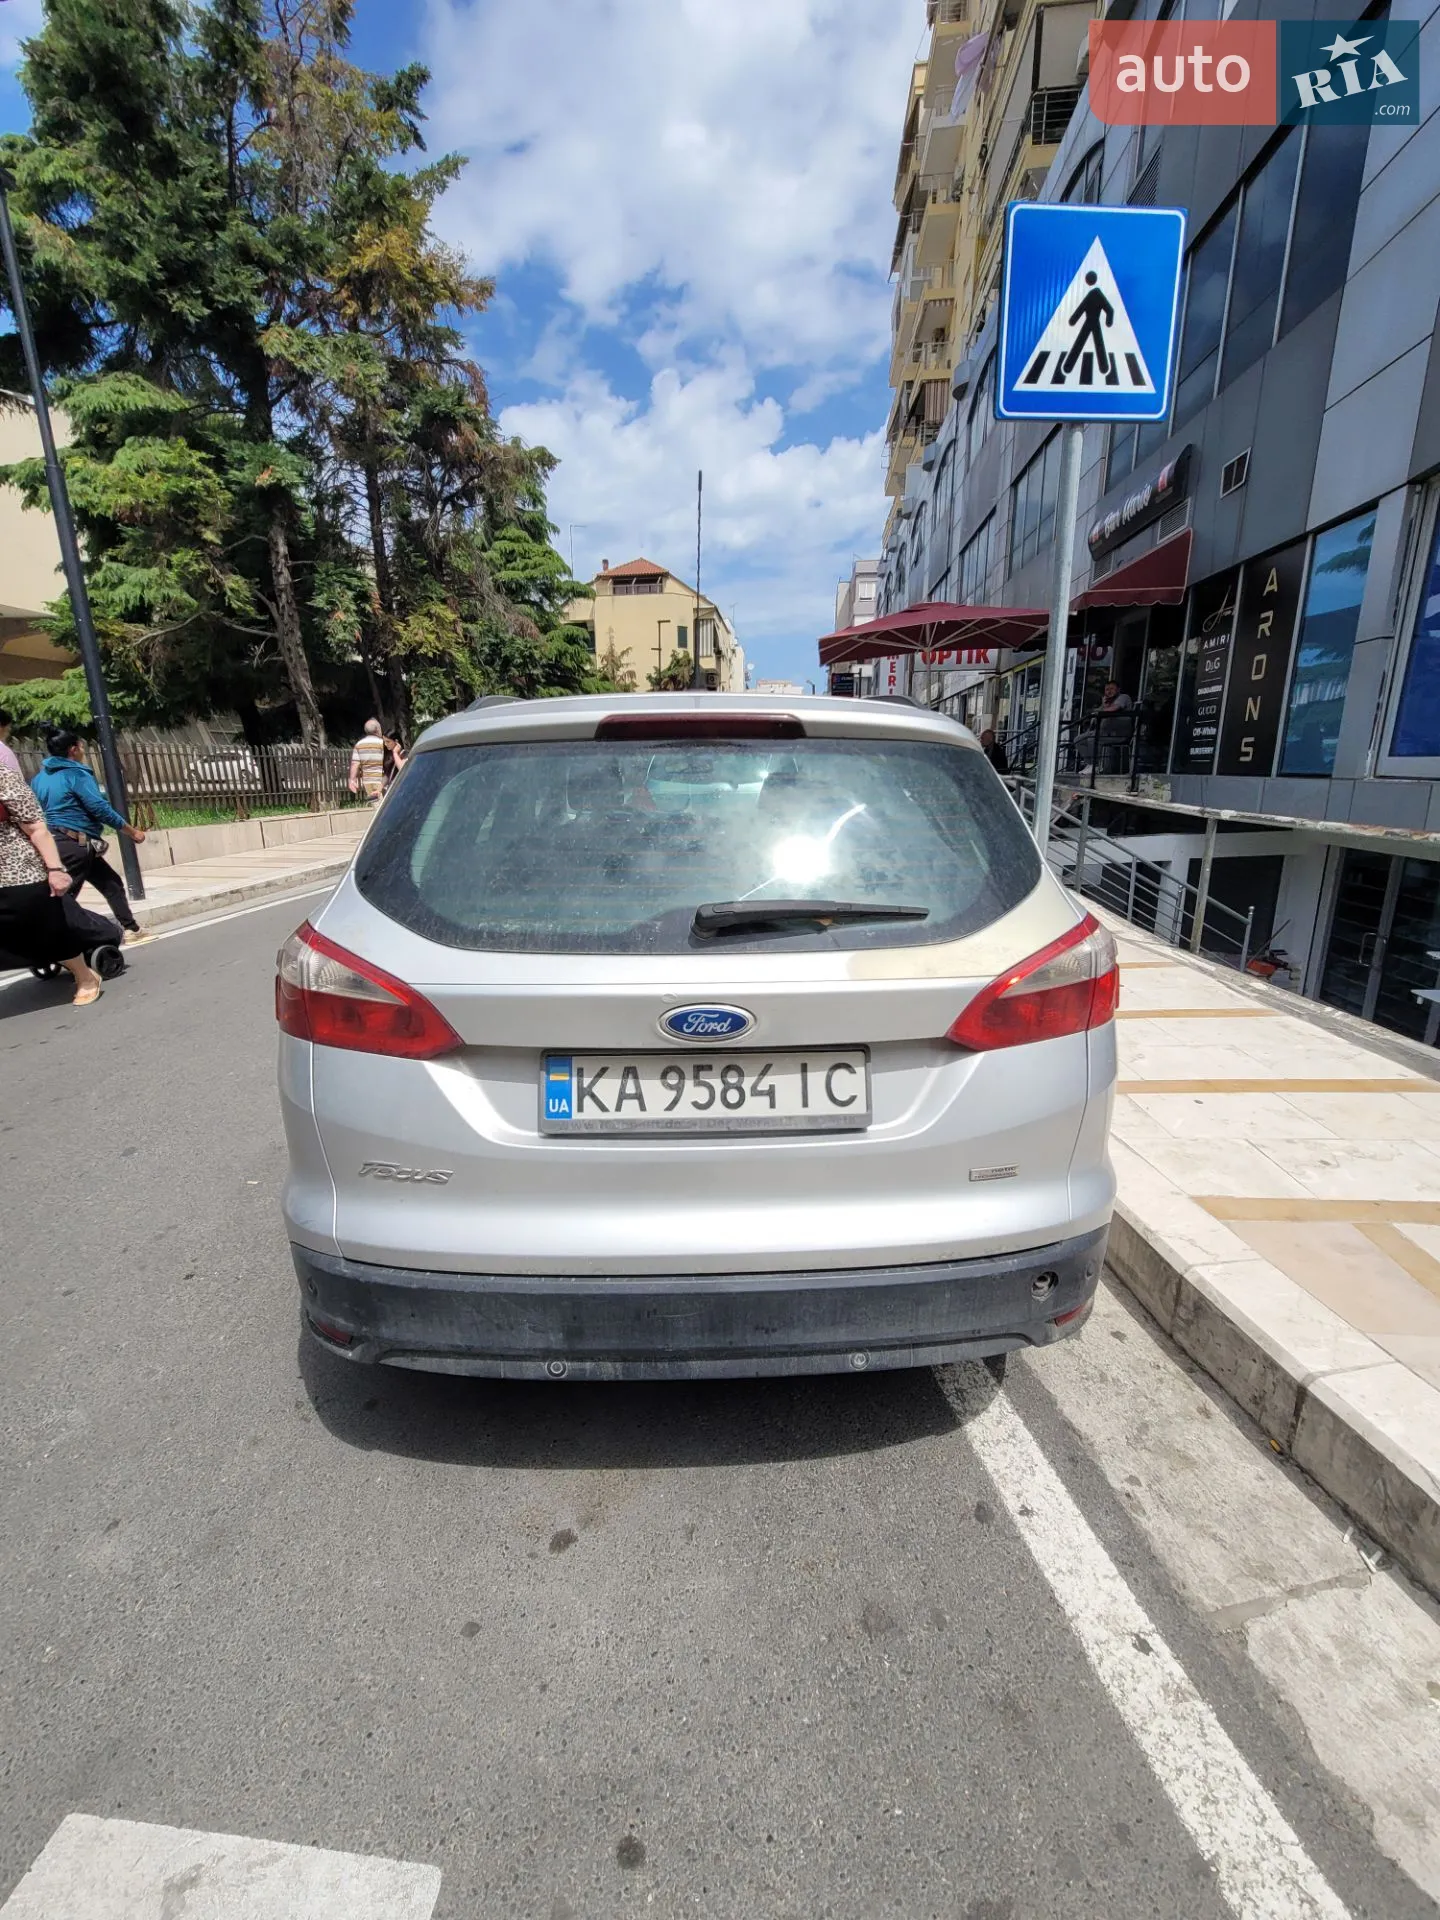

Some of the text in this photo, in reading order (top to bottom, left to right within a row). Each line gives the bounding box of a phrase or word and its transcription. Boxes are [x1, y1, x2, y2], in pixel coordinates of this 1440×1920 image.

[921, 647, 990, 665] OPTIK
[1239, 566, 1279, 763] ARONS
[684, 1012, 732, 1034] Ford
[576, 1062, 857, 1114] KA 9584 IC
[548, 1099, 570, 1113] UA
